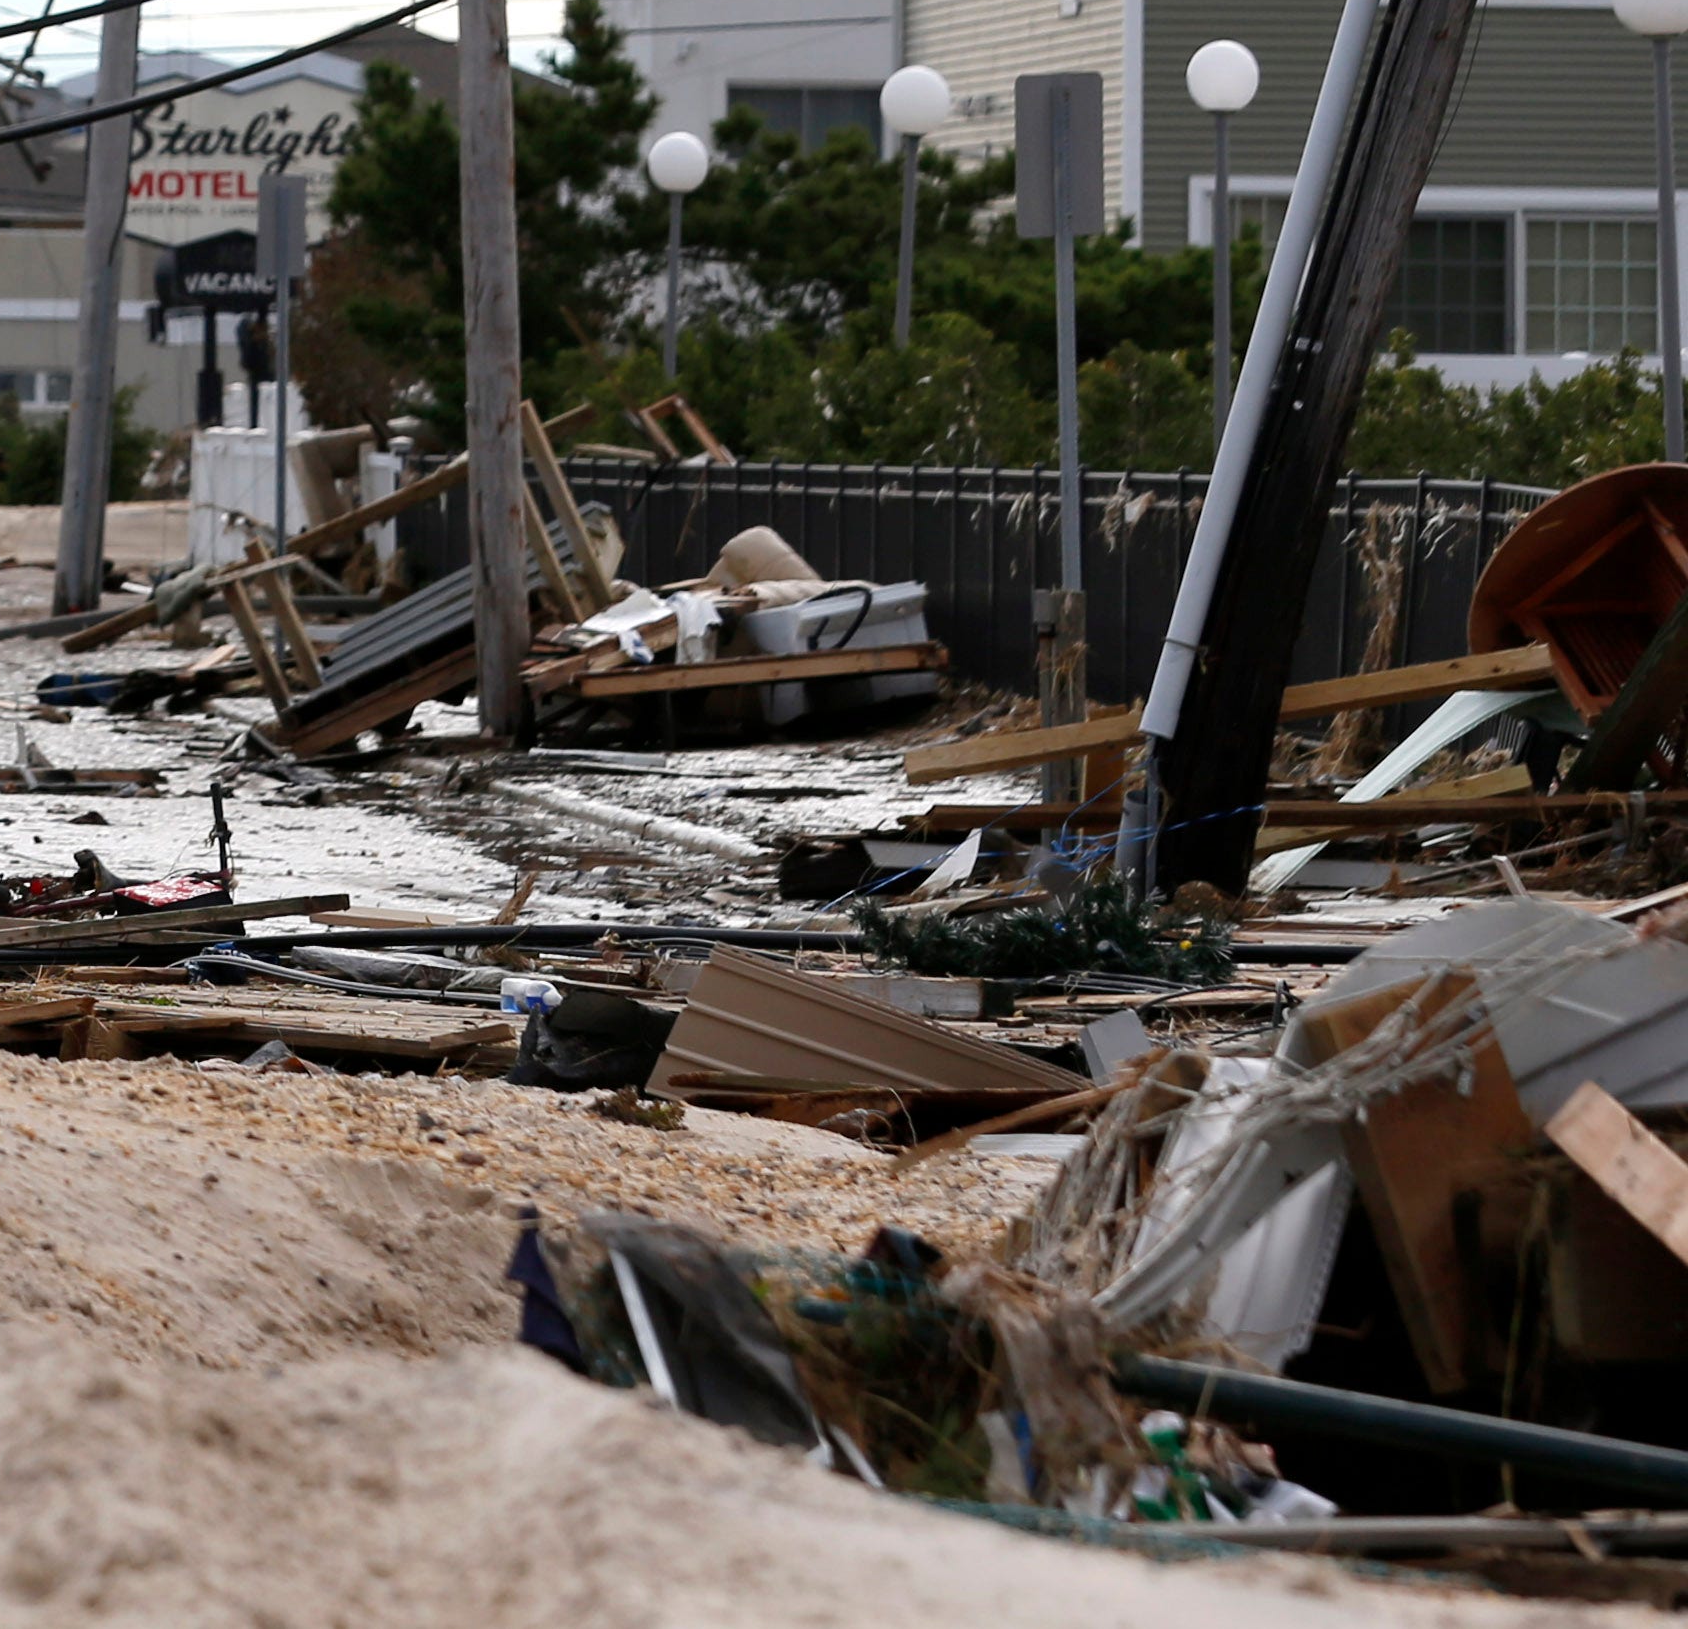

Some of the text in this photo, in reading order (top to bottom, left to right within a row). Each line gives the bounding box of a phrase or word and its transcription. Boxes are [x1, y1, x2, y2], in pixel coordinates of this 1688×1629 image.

[130, 101, 358, 174] Starlight
[128, 170, 259, 200] MOTEL
[184, 273, 276, 293] VACANC
